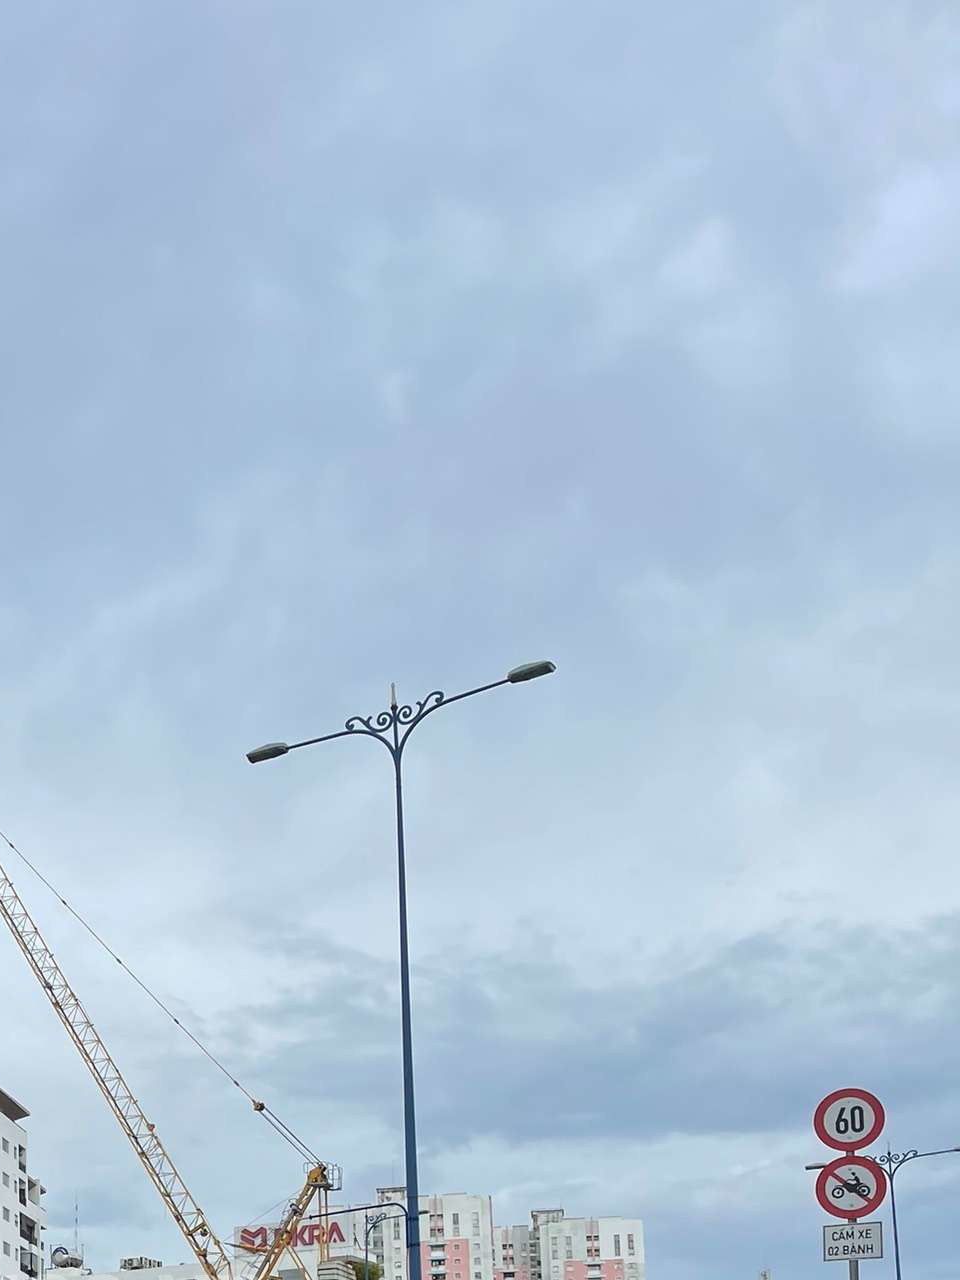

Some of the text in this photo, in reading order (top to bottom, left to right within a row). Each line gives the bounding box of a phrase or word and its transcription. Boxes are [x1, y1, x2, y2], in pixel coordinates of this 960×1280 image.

[835, 1106, 865, 1134] 60
[274, 1222, 345, 1248] KRA
[858, 1229, 872, 1240] XE
[828, 1246, 840, 1256] 02
